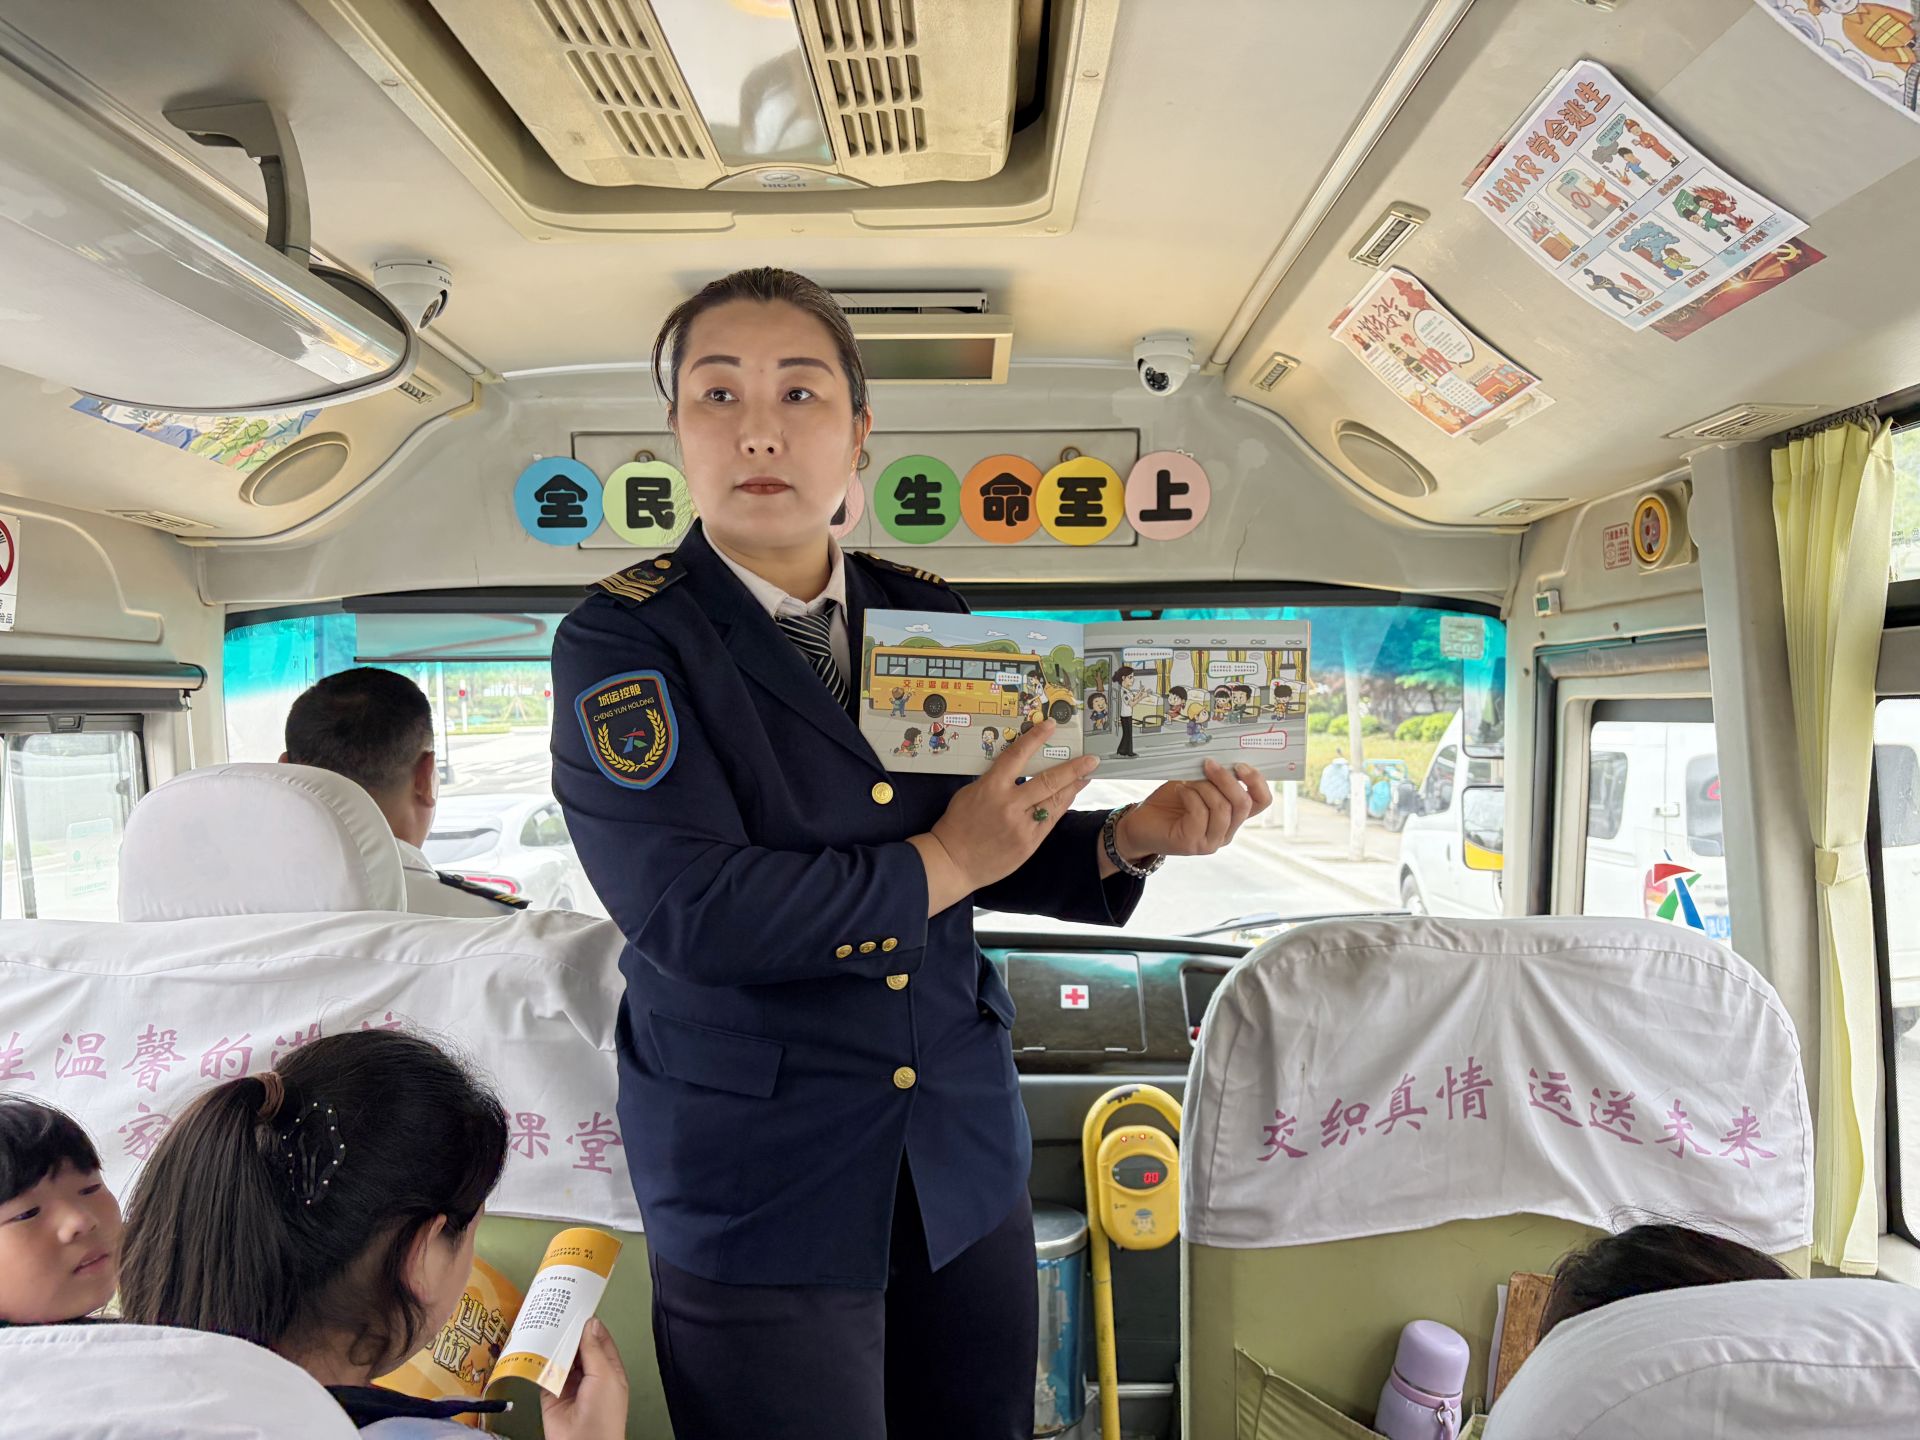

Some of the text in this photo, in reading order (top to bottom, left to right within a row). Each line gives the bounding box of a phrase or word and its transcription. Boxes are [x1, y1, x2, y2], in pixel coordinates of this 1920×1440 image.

[598, 683, 642, 707] 城运控股
[593, 697, 655, 722] CHENG YUN HOLDING
[1257, 1056, 1778, 1169] 交织真情 运送未来
